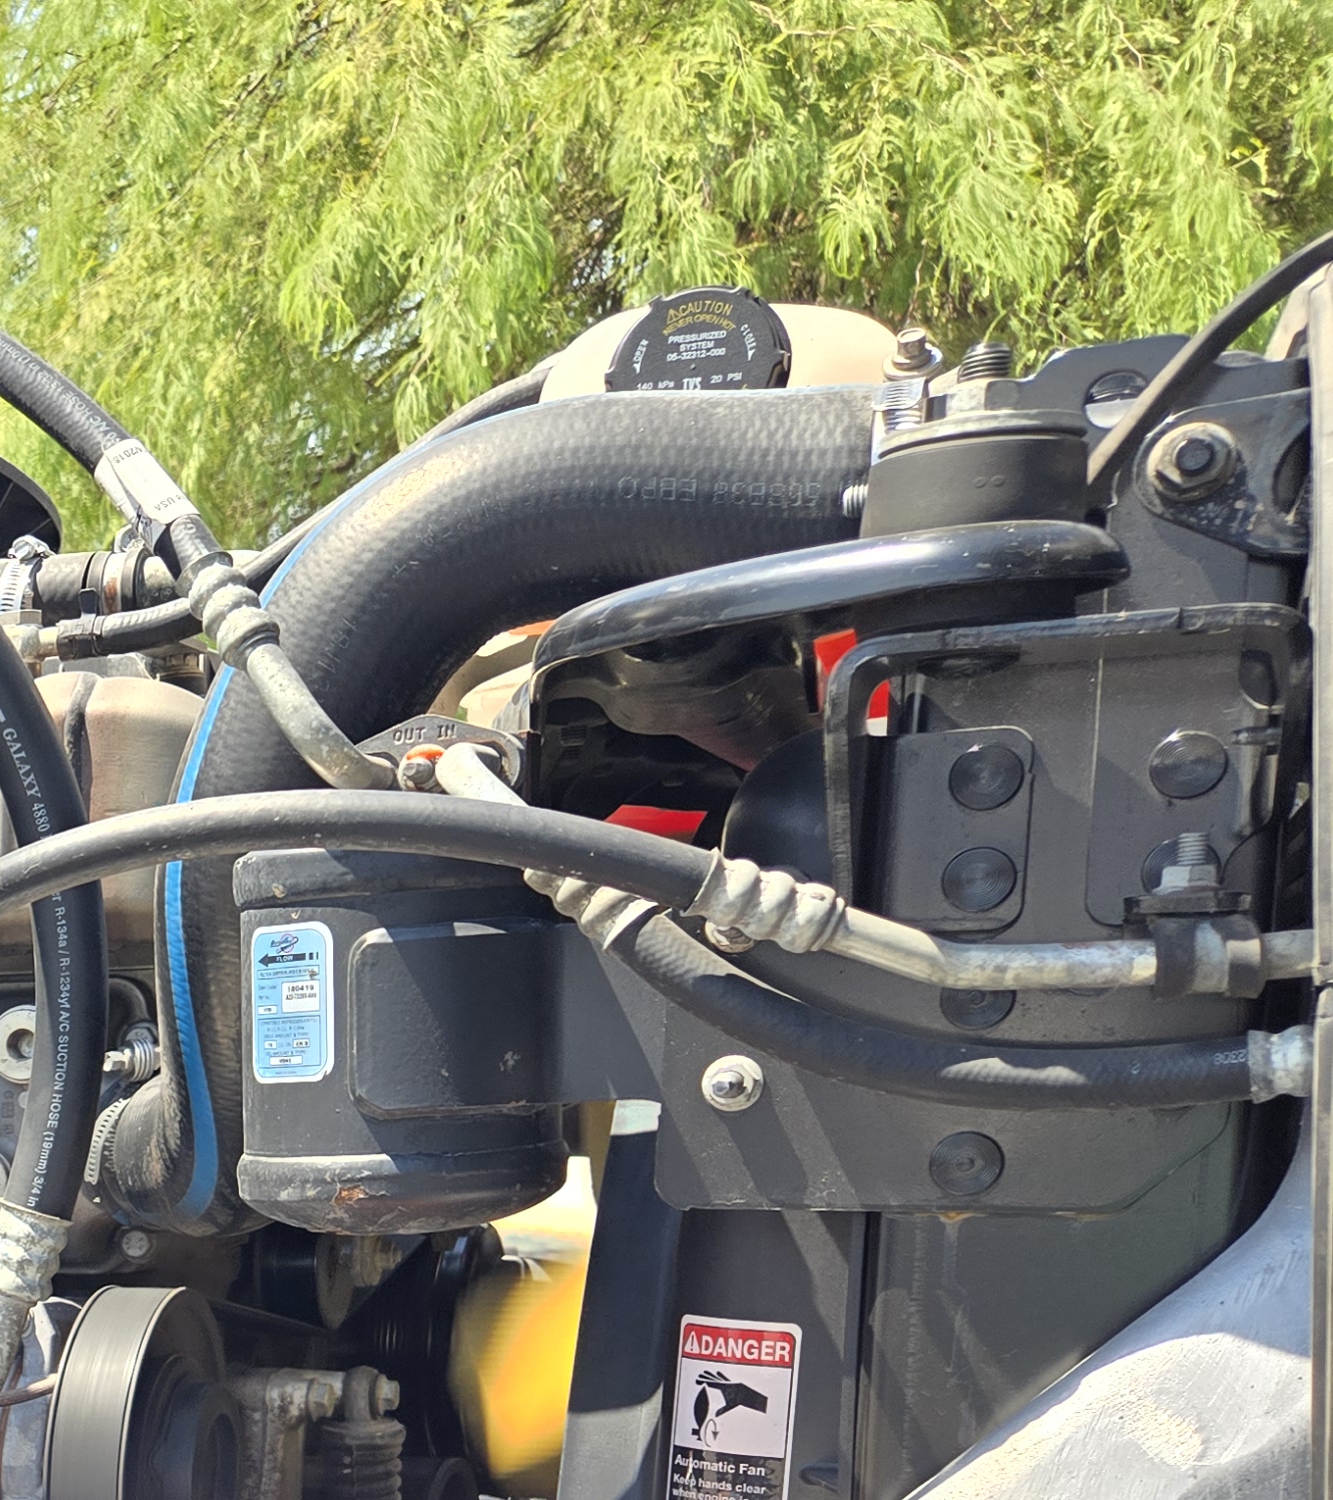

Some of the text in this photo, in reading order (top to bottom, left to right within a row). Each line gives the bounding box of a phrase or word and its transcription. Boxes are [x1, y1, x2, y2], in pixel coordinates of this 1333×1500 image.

[679, 300, 733, 316] CAUTION
[662, 314, 737, 336] NEVER OPEN HOT
[668, 330, 727, 344] PRESSURIZED
[679, 341, 715, 352] SYSTEM
[392, 723, 457, 746] OUT IN
[3, 727, 42, 799] GALAXY
[32, 803, 51, 833] 4880
[54, 906, 68, 947] R-134a
[58, 1010, 70, 1033] A/C
[54, 1034, 70, 1091] SUCTION
[46, 1093, 63, 1129] HOSE
[34, 1131, 55, 1174] (19mm)
[31, 1175, 45, 1195] 3/4
[27, 1196, 40, 1208] in
[700, 1334, 791, 1363] DANGER
[674, 1454, 766, 1477] Automatic Fan
[672, 1487, 697, 1500] when
[673, 1473, 767, 1495] Keep hands clear
